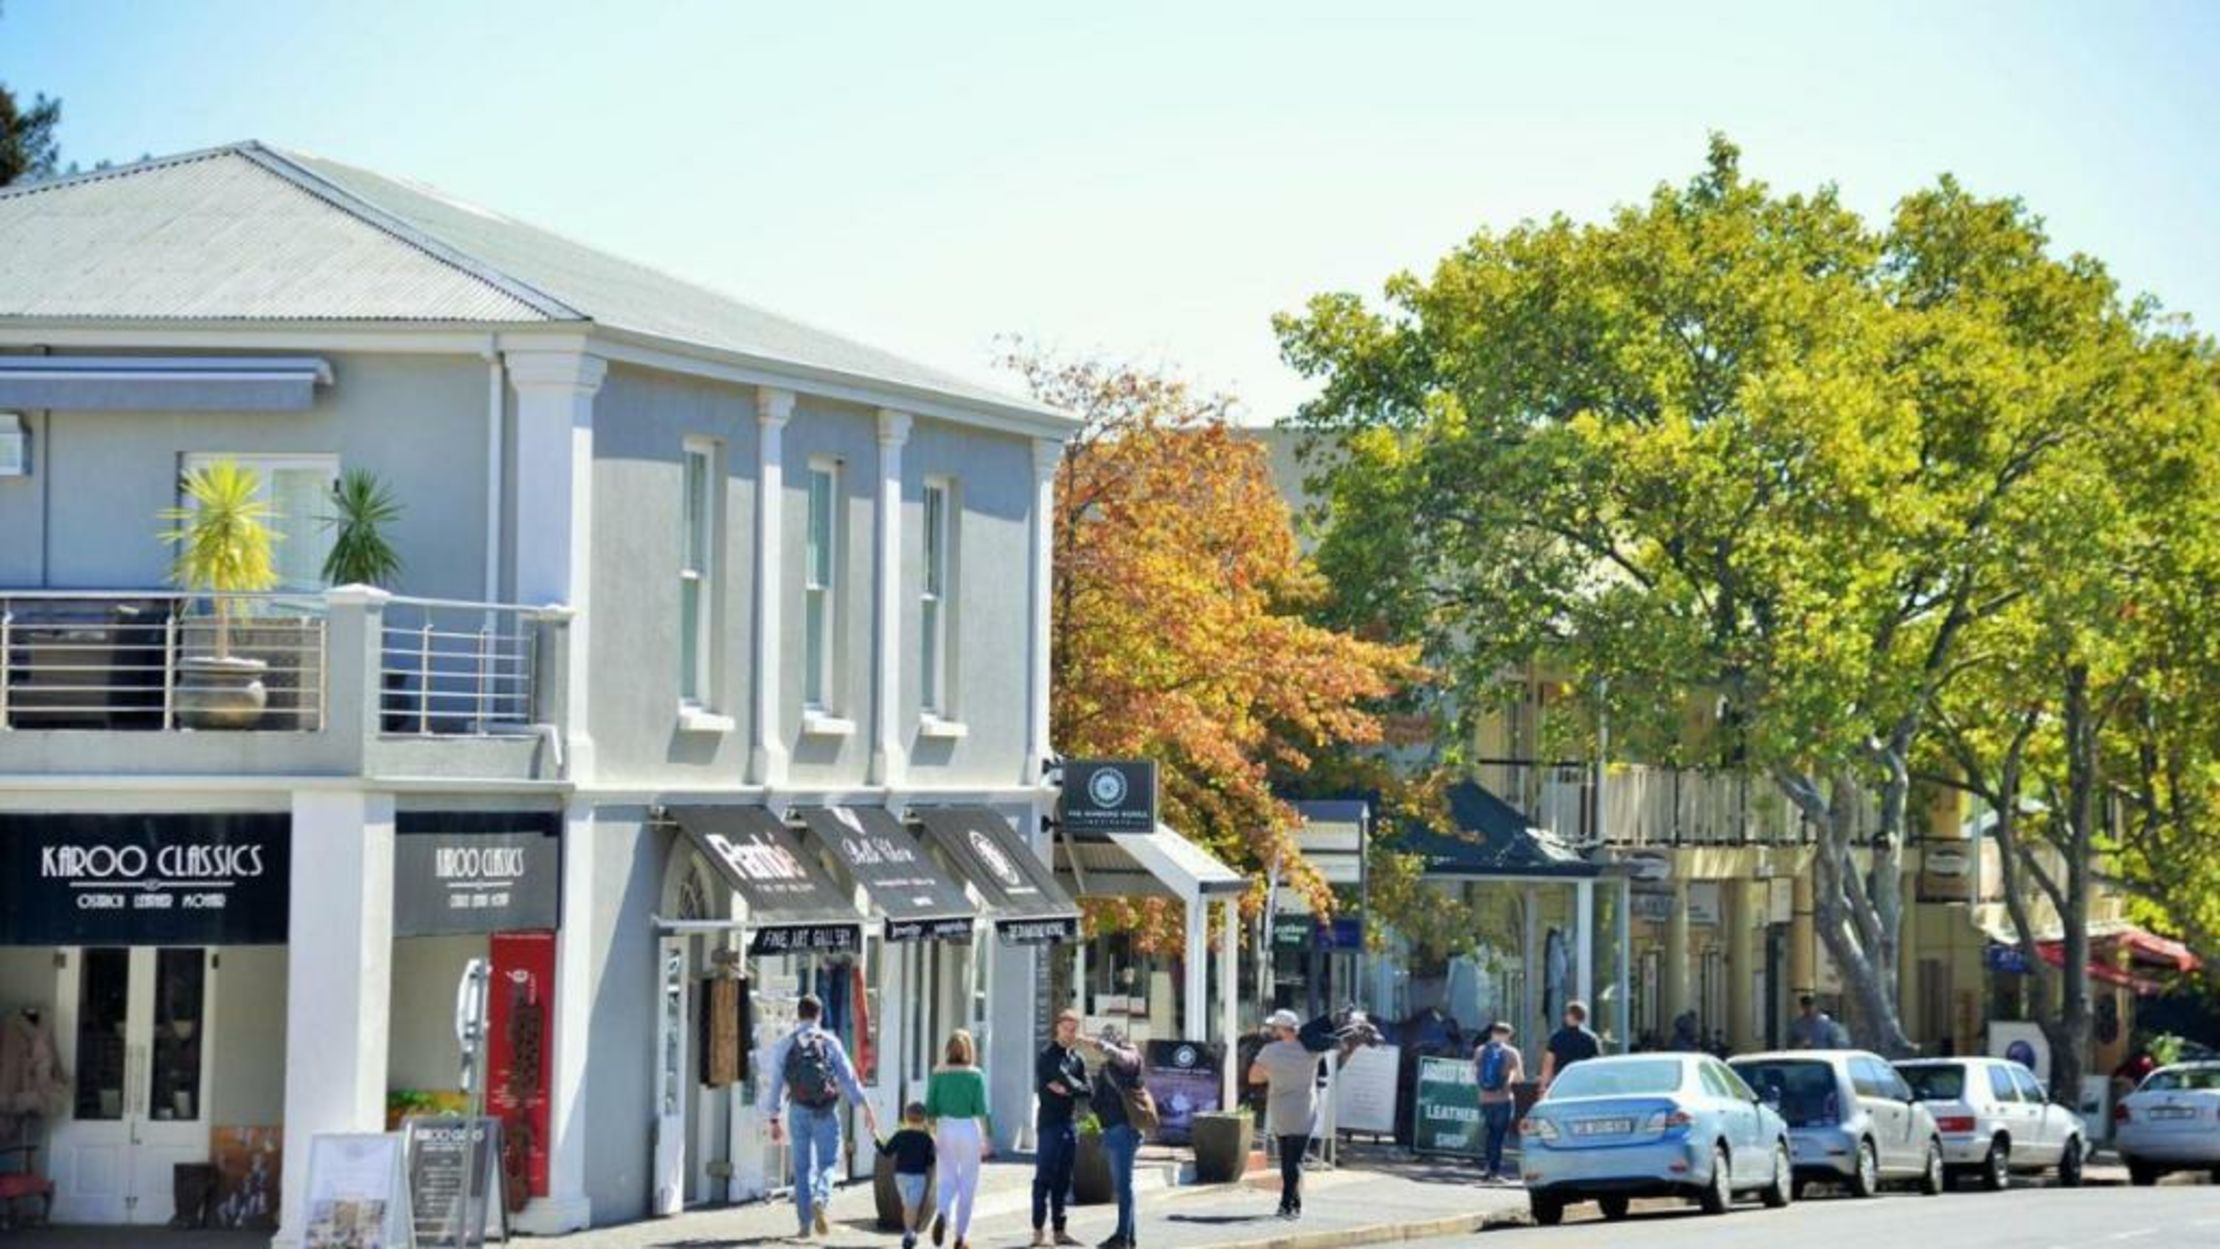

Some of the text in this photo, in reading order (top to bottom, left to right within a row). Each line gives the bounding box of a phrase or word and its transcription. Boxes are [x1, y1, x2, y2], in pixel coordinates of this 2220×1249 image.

[42, 844, 263, 877] KAROO CLASSICS
[1424, 1105, 1479, 1122] LEATHER
